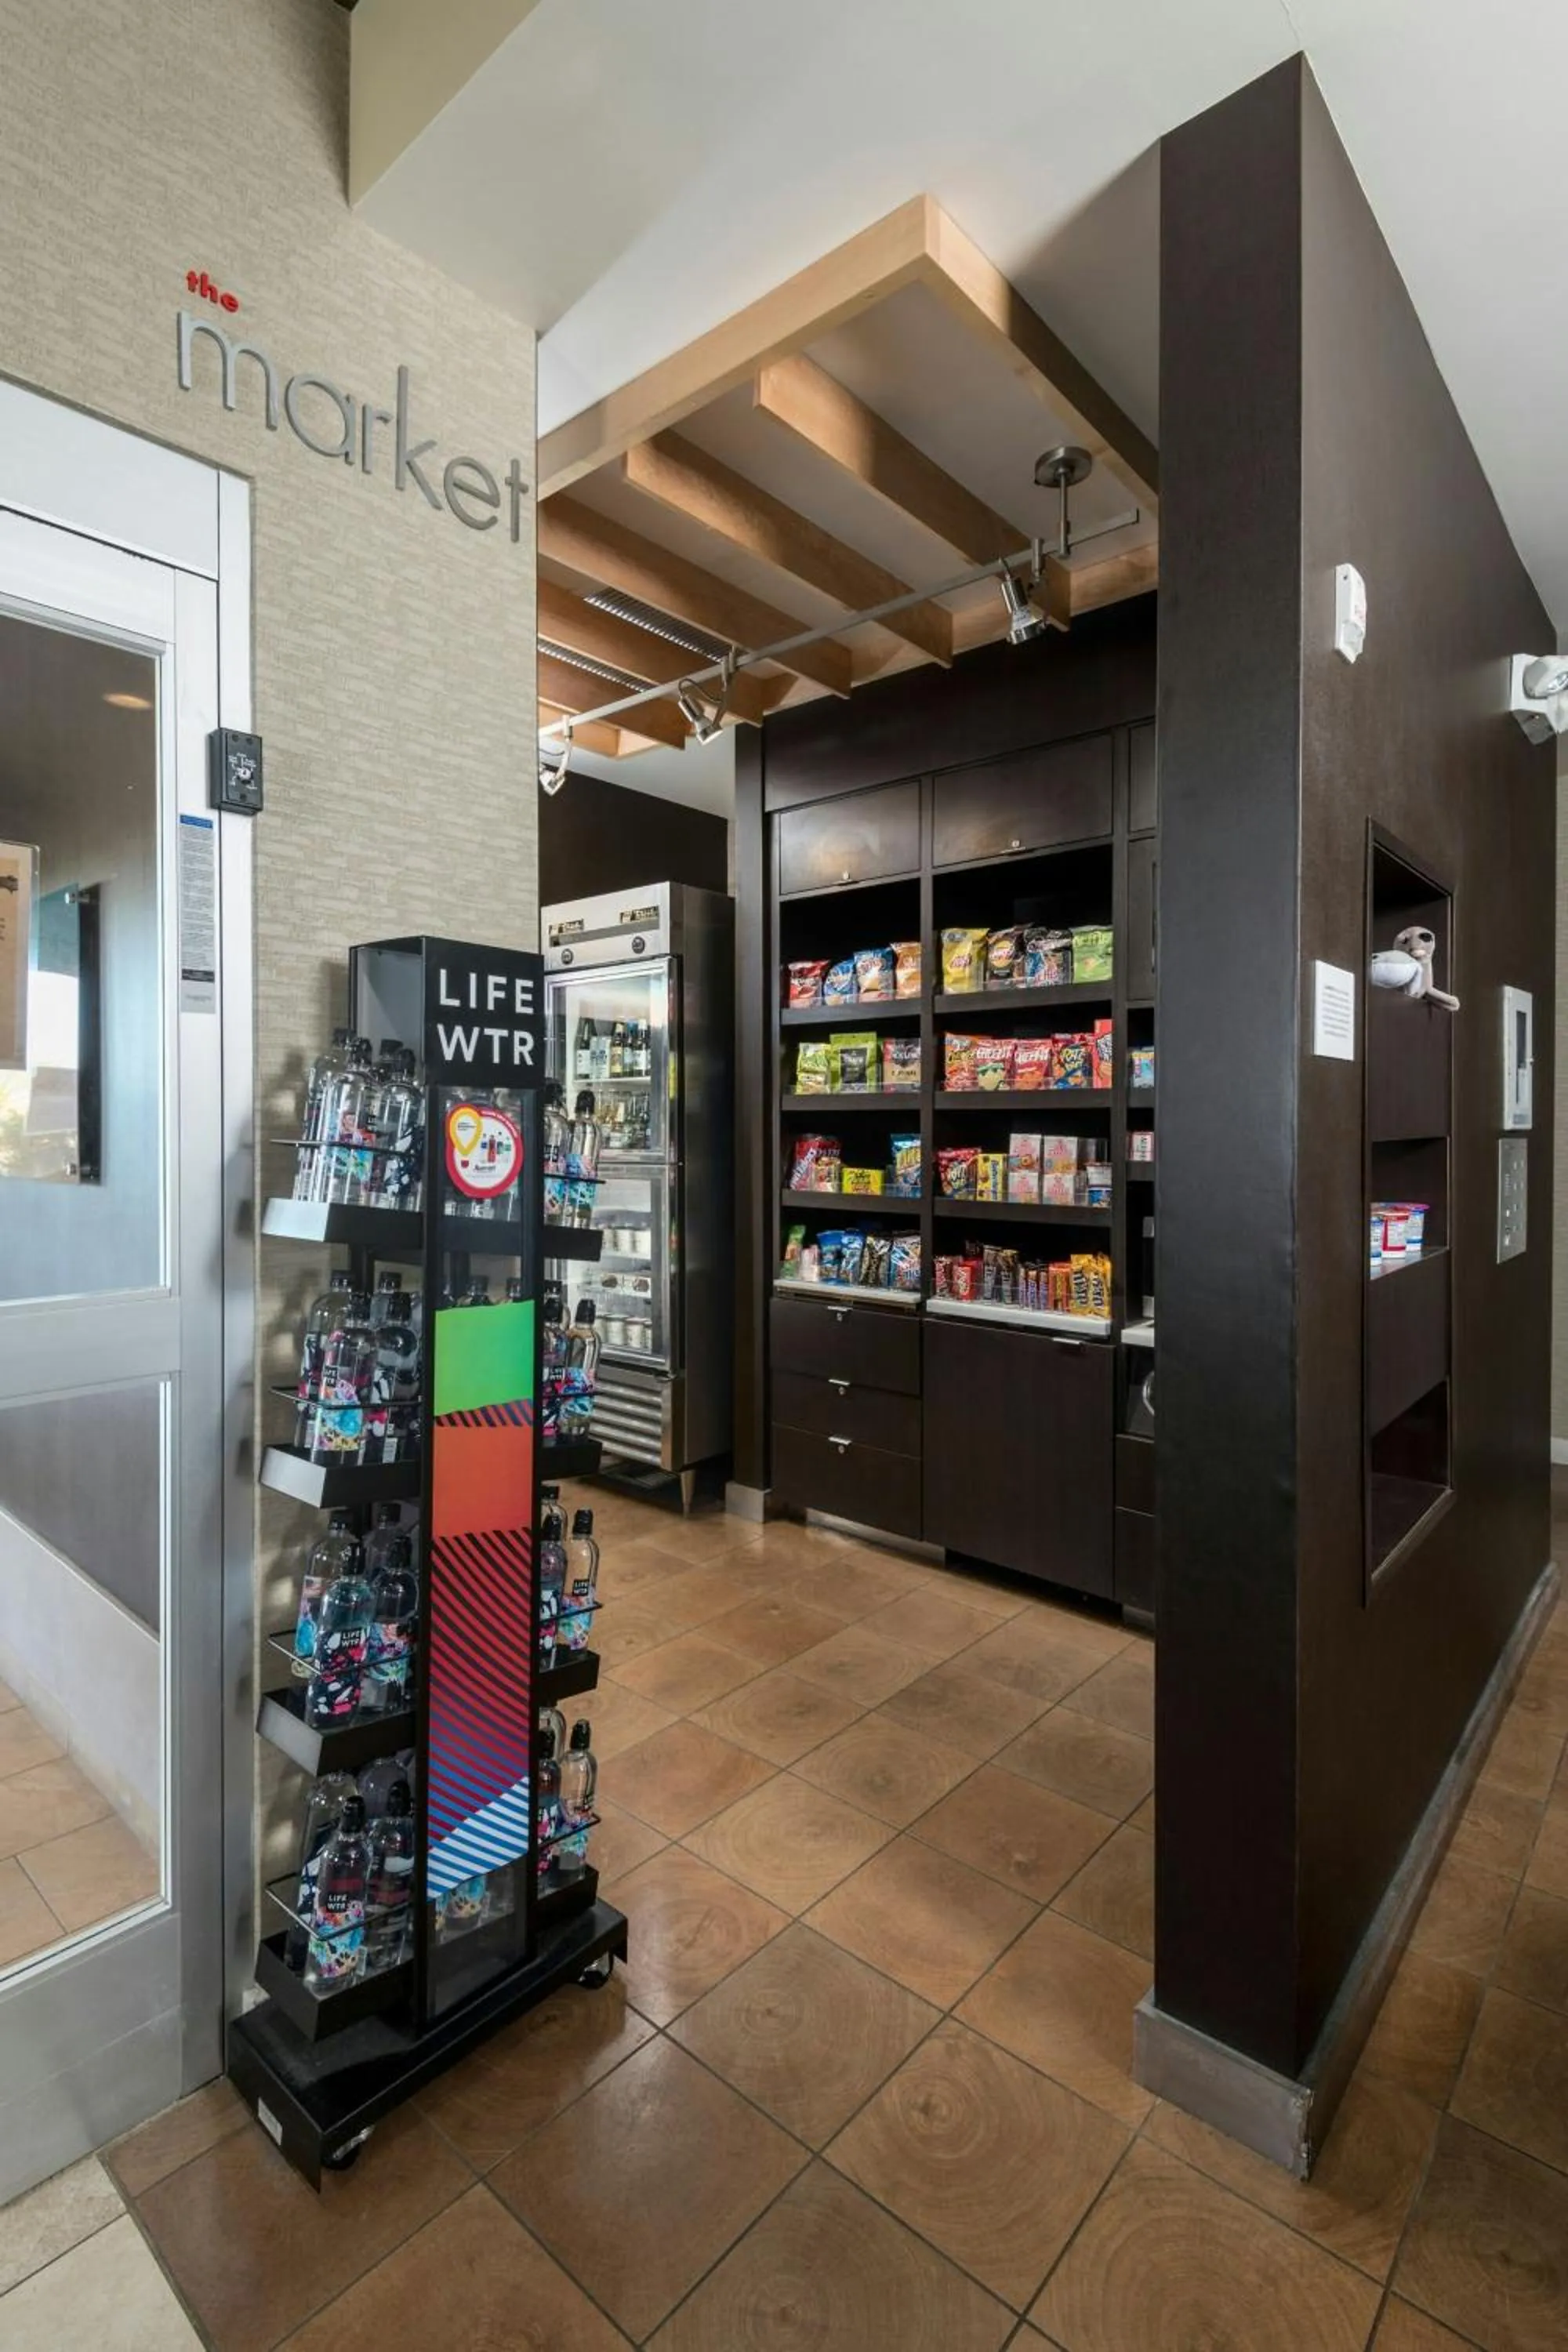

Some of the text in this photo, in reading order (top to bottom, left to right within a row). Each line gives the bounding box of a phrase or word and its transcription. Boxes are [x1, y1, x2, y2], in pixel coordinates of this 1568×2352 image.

[186, 270, 239, 312] the
[176, 310, 529, 543] market
[439, 968, 535, 1014] LIFE
[437, 1023, 535, 1065] WTR
